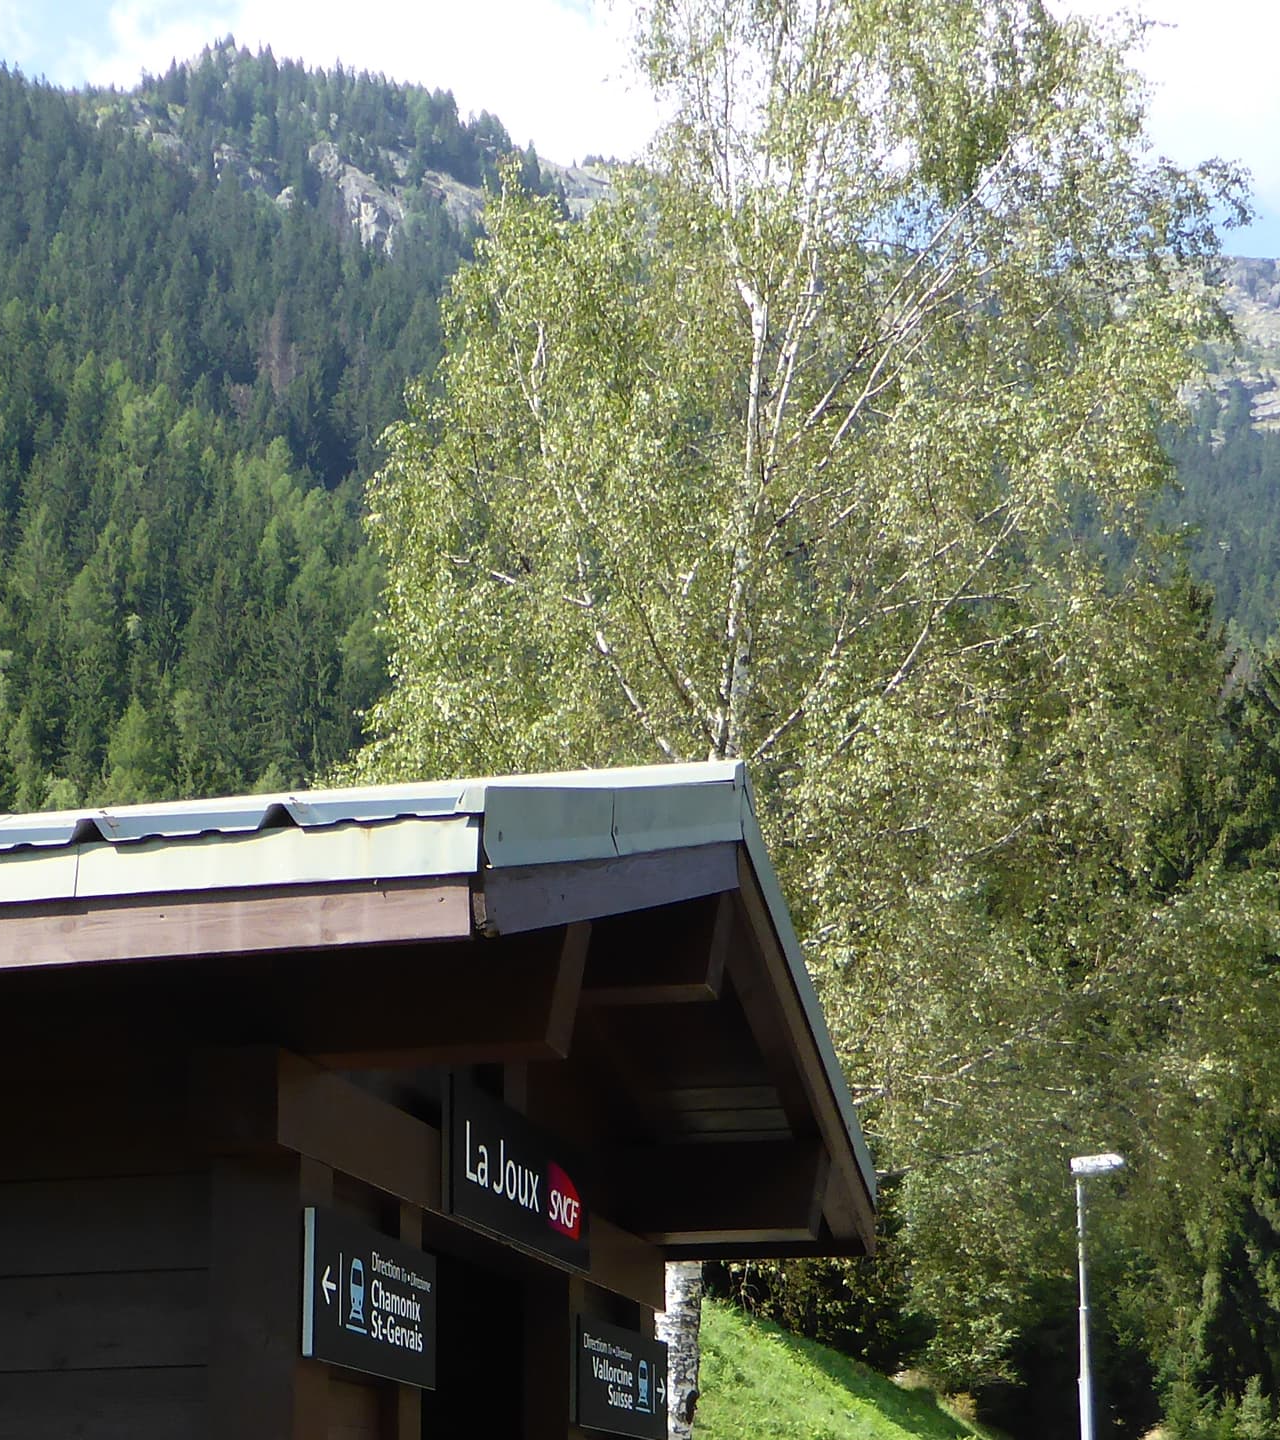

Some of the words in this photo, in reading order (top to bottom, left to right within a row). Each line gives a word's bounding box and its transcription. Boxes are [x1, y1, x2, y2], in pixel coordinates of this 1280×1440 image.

[466, 1120, 488, 1188] La
[492, 1139, 539, 1213] Joux
[549, 1189, 580, 1228] SNCF
[371, 1252, 401, 1280] Direction
[371, 1280, 421, 1322] Chamonix
[371, 1311, 423, 1353] St-Gervais
[592, 1356, 633, 1387] Vallorcine
[607, 1384, 633, 1410] Suisse
